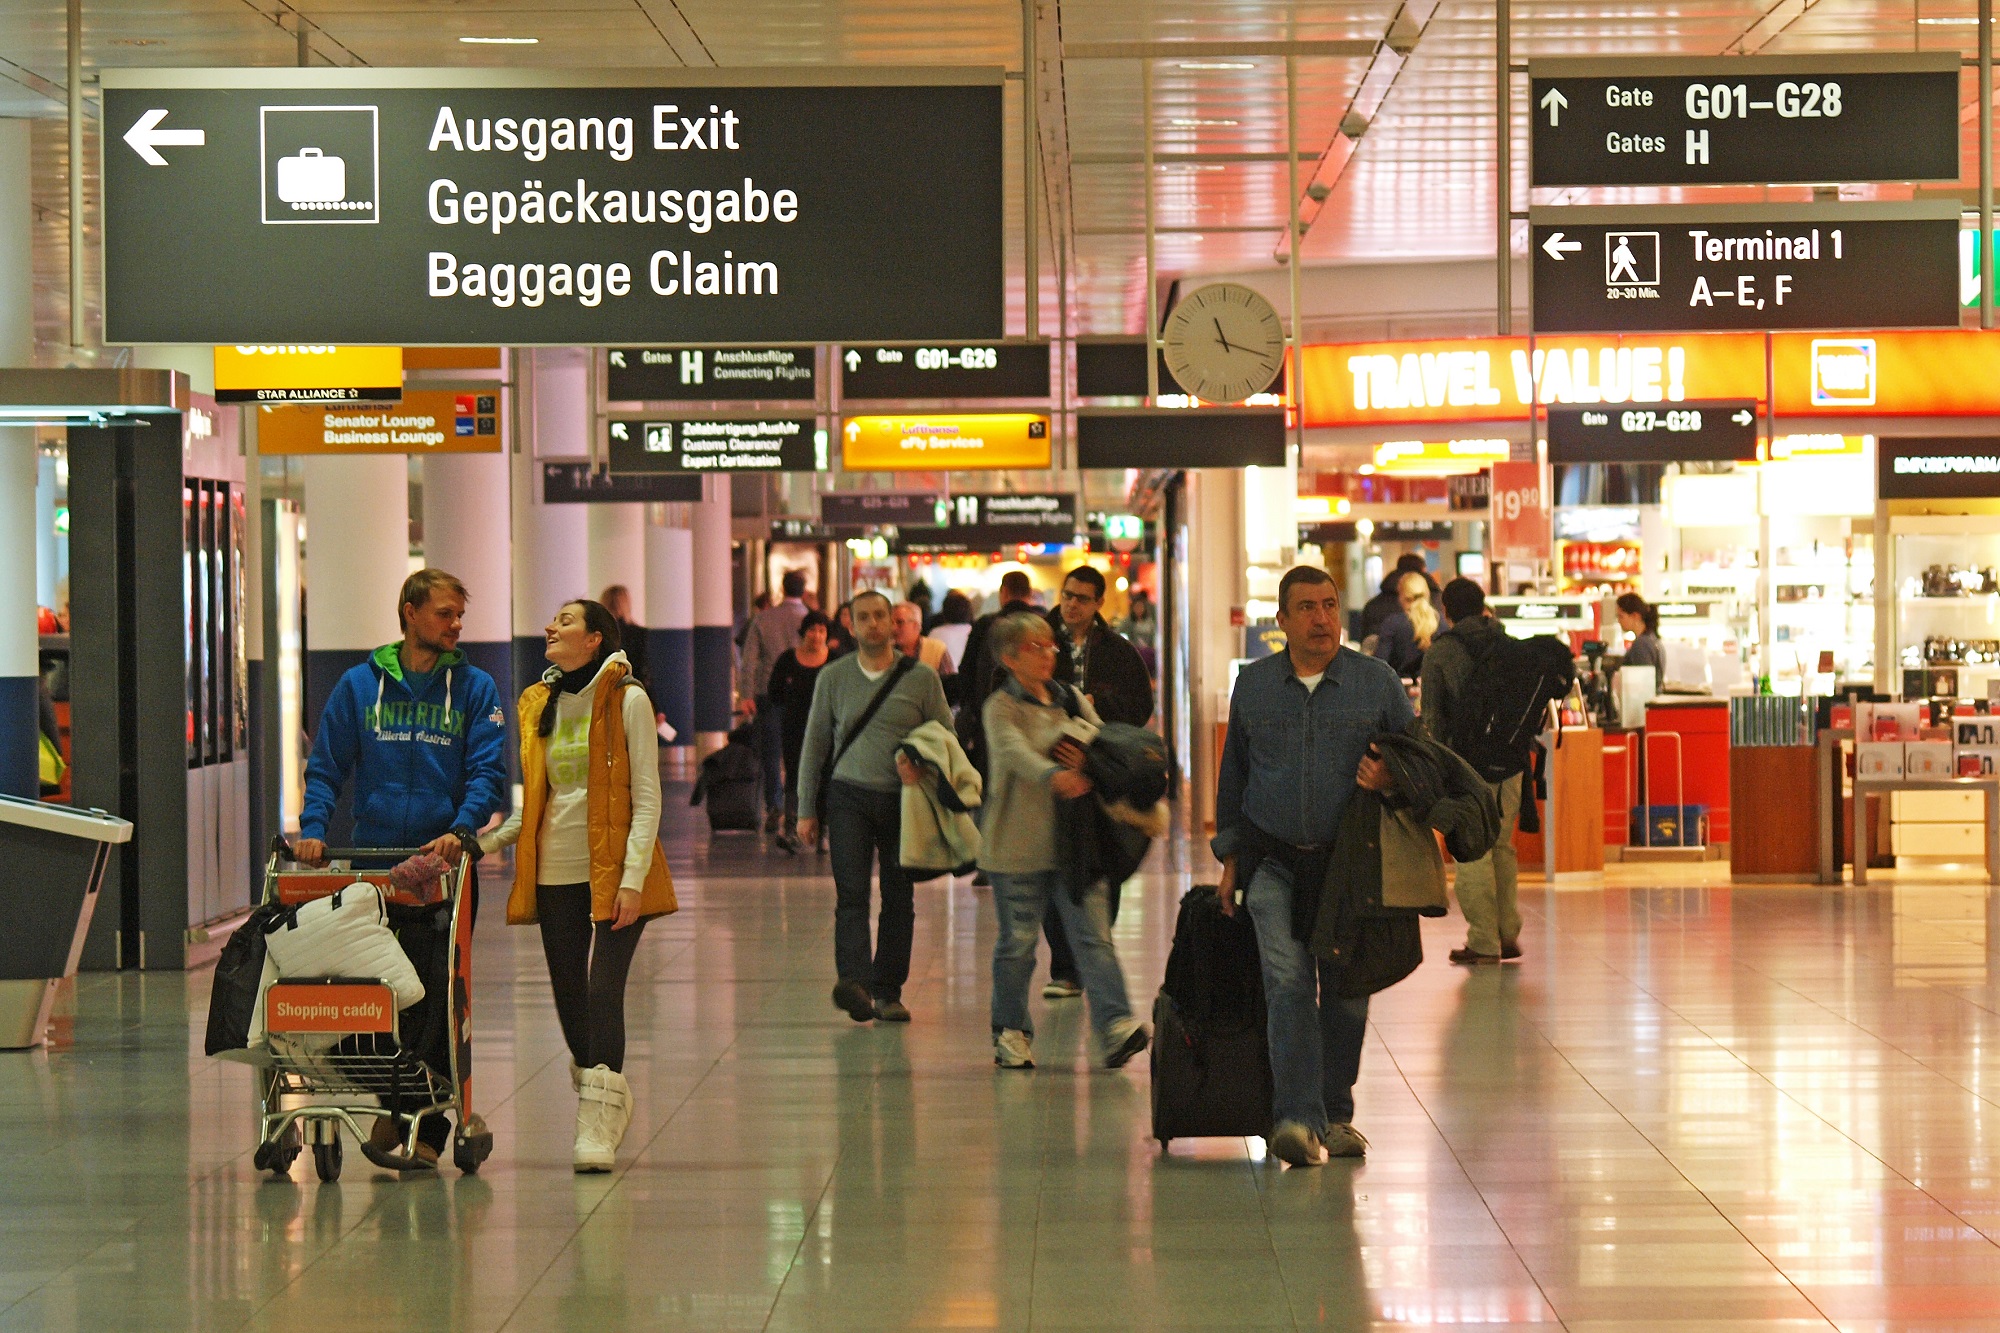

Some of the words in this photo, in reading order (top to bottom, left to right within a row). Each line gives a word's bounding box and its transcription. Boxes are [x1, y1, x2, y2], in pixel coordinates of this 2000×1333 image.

[1606, 85, 1654, 107] Gate
[1685, 82, 1842, 119] G01–G28
[428, 106, 633, 162] Ausgang
[652, 104, 740, 150] Exit
[1606, 131, 1666, 153] Gates
[1685, 129, 1710, 165] H
[427, 177, 799, 235] Gepäckausgabe
[1688, 229, 1819, 261] Terminal
[1830, 229, 1843, 259] 1
[428, 251, 631, 307] Baggage
[649, 250, 778, 296] Claim
[1638, 287, 1660, 299] Min.
[1776, 275, 1792, 306] F
[876, 348, 903, 363] Gate
[642, 350, 672, 364] Gates
[680, 350, 703, 384] H
[714, 350, 794, 364] Anschlussflüge
[714, 366, 773, 380] Connecting
[775, 366, 811, 380] Flights
[1348, 351, 1500, 410] TRAVEL
[257, 389, 286, 399] STAR
[289, 389, 345, 399] ALLIANCE
[324, 414, 379, 427] Senator
[381, 414, 435, 429] Lounge
[901, 423, 959, 434] Lufthansa
[1582, 412, 1608, 425] Gate
[1621, 411, 1702, 432] G27–G28
[324, 430, 389, 444] Business
[391, 430, 444, 445] Lounge
[682, 438, 727, 451] Customs
[929, 436, 984, 448] Services
[682, 453, 717, 469] Export
[415, 730, 452, 746] Austria
[277, 1002, 339, 1019] Shopping
[343, 1002, 383, 1019] caddy
